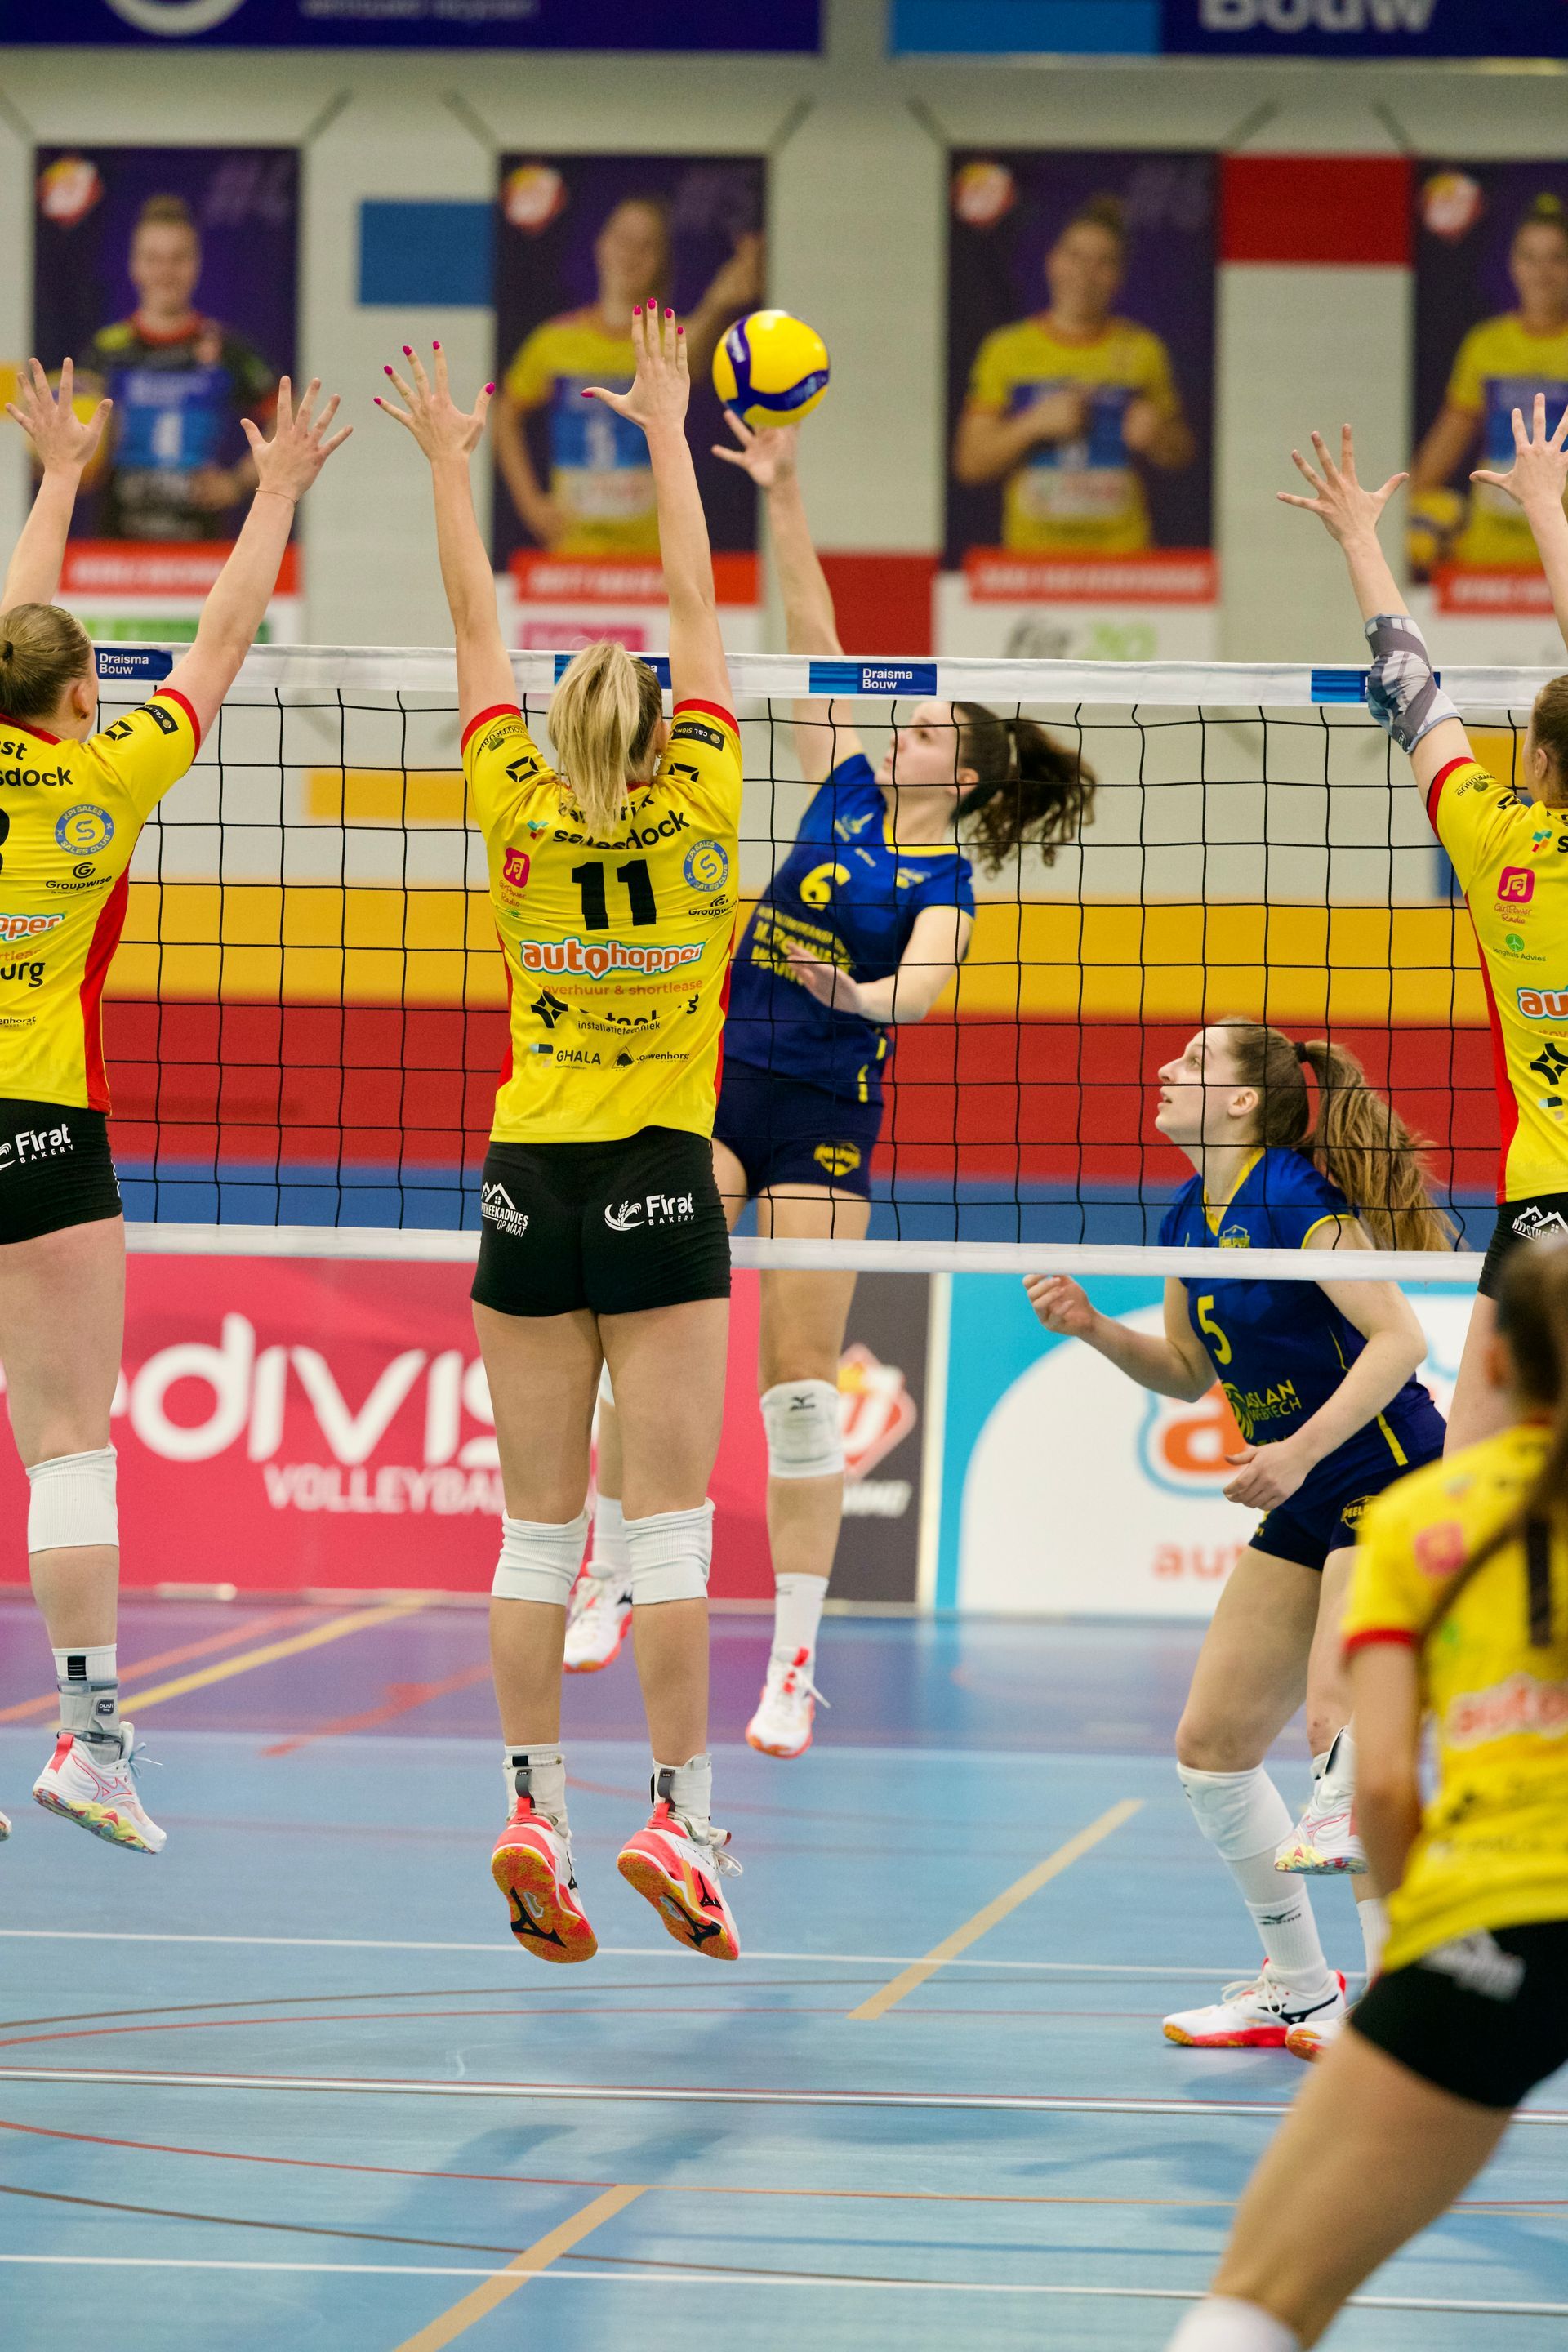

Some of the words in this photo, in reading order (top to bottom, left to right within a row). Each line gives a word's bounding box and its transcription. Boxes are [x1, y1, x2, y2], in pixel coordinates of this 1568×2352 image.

[99, 653, 149, 665] Draisma
[99, 663, 133, 675] Bouw
[862, 668, 913, 679] Draisma
[862, 679, 897, 689] Bouw
[0, 741, 28, 760] st
[63, 808, 77, 821] KPI
[76, 805, 103, 817] SALES
[60, 840, 88, 854] SALES
[90, 834, 111, 853] CLUB
[46, 875, 113, 891] Groupwise
[800, 862, 851, 912] 6
[572, 858, 657, 931] 11
[521, 939, 703, 978] autohopper
[1521, 953, 1547, 962] Advies
[614, 985, 625, 995] &
[628, 979, 703, 996] shortlease
[556, 1049, 601, 1066] GHALA
[15, 1123, 71, 1156] Firat
[20, 1144, 74, 1164] BAKERY
[645, 1192, 694, 1218] Firat
[497, 1219, 507, 1231] OP
[506, 1222, 527, 1238] MAAT
[648, 1214, 695, 1226] BAKERY
[1197, 1294, 1232, 1365] 5
[1245, 1379, 1295, 1409] ASLAN
